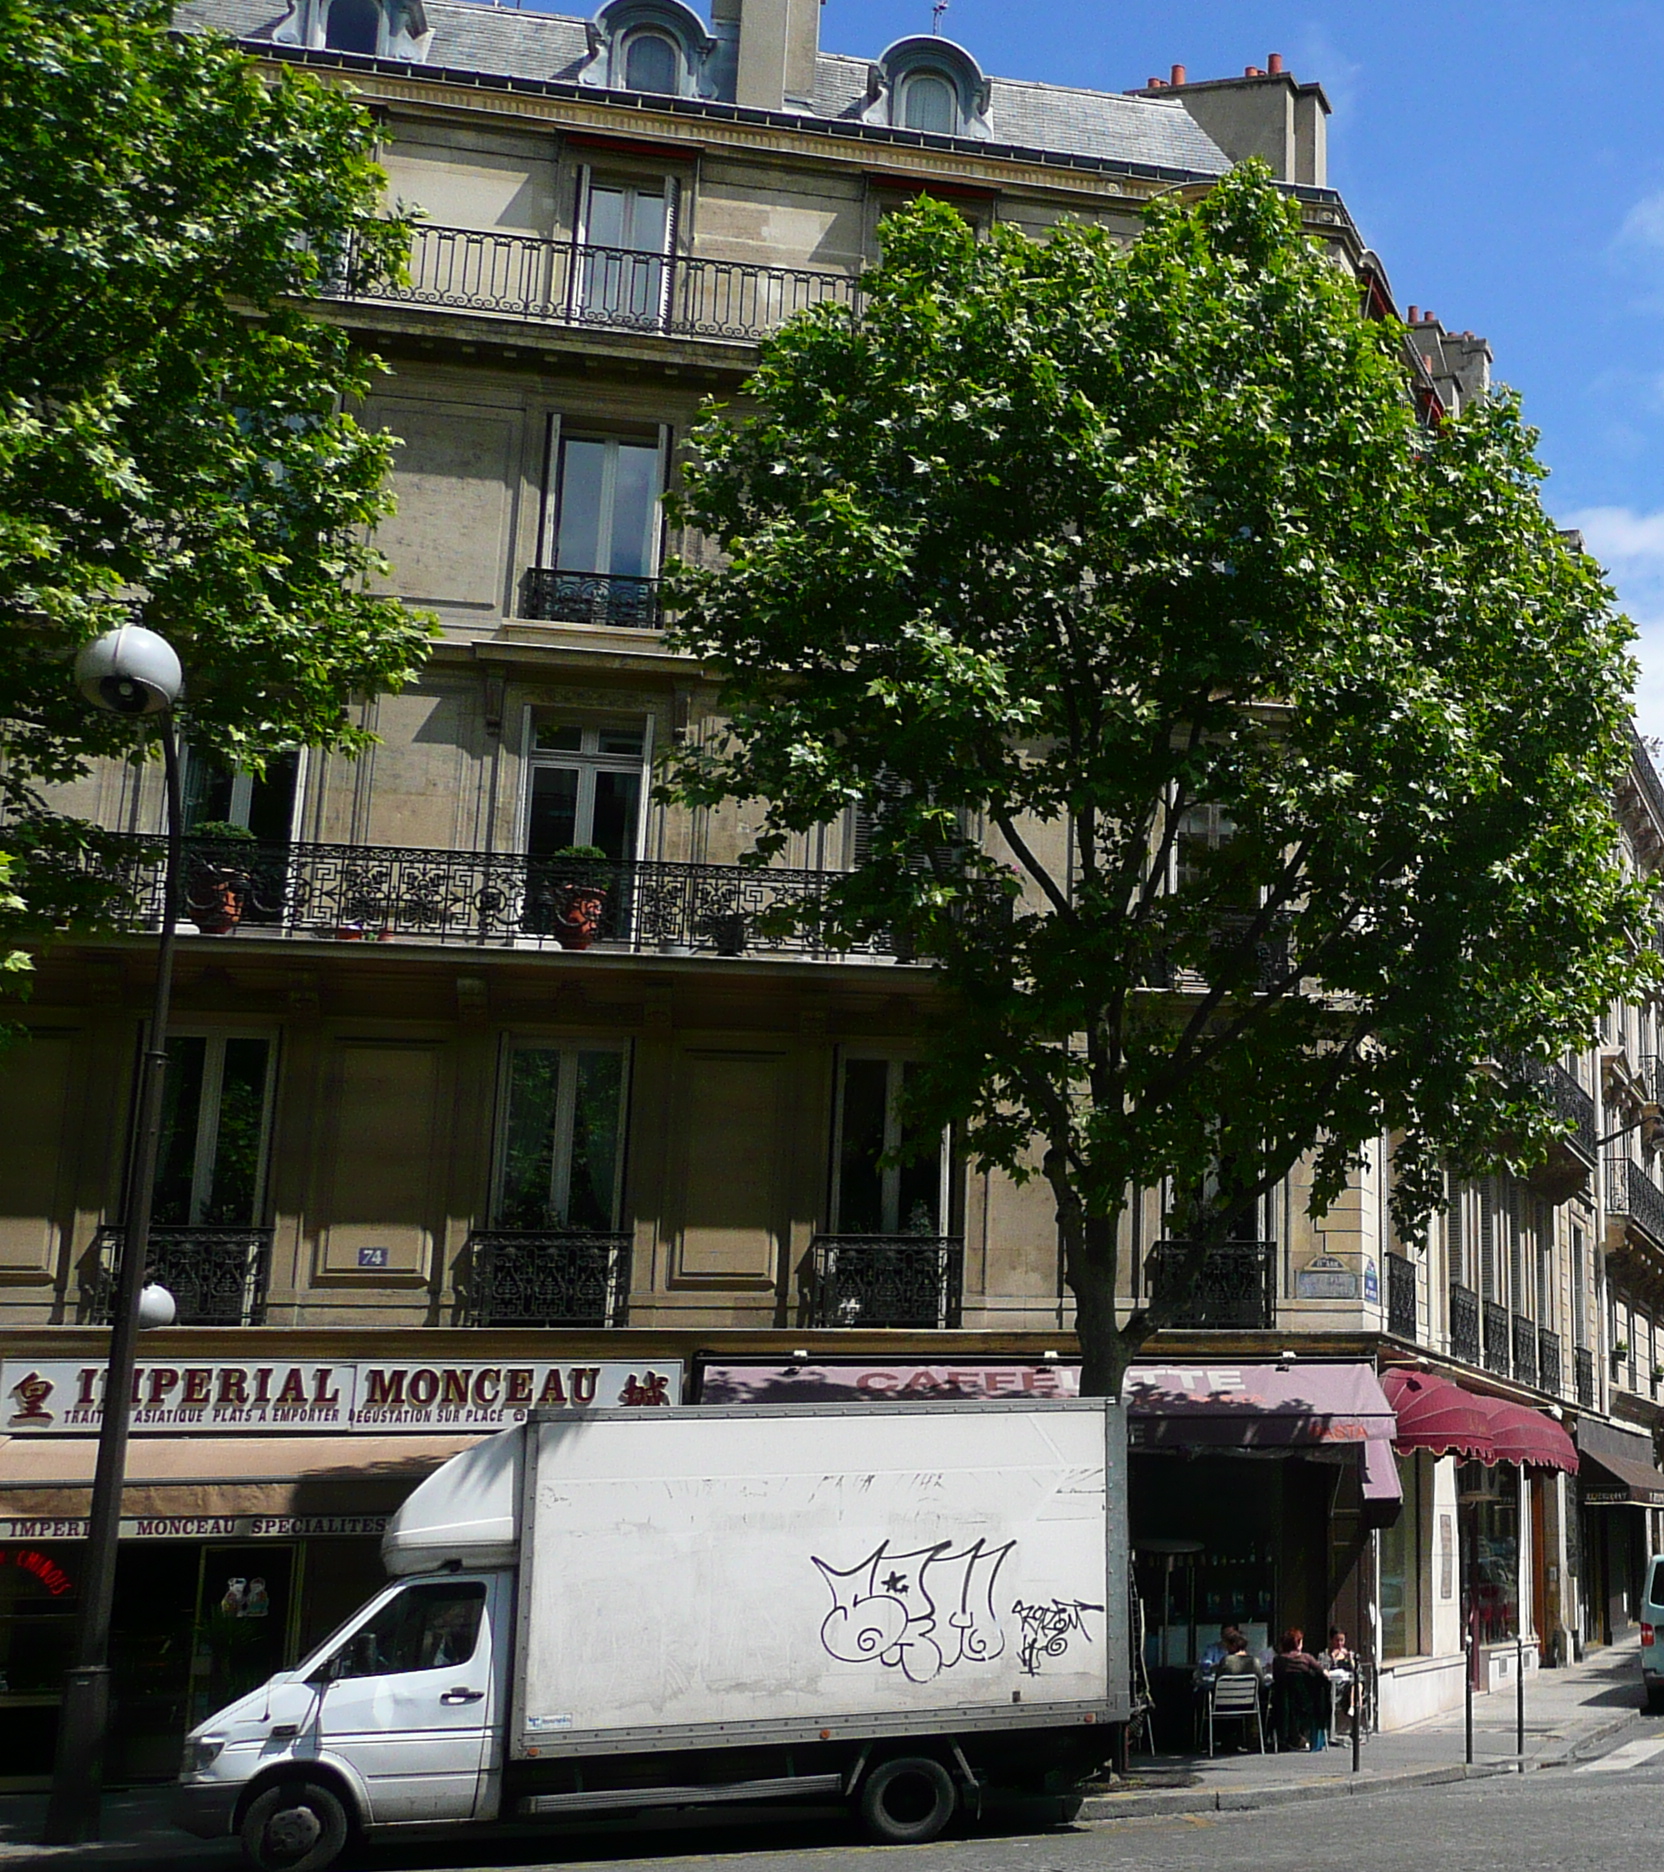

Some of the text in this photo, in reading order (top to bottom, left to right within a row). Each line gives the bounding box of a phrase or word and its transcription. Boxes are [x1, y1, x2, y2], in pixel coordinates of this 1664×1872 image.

[362, 1250, 382, 1265] 74
[366, 1367, 600, 1405] MONCEAU
[13, 1371, 54, 1425] 皇
[63, 1409, 104, 1424] TRAIT
[133, 1408, 204, 1424] ASIATIQUE
[212, 1408, 253, 1423] PLATS
[272, 1408, 340, 1422] EMPORTER
[437, 1408, 461, 1423] SUR
[465, 1408, 504, 1422] PLACE
[1308, 1423, 1369, 1441] PASTA
[9, 1517, 386, 1538] IMPERI MONCEAU SPECIALITES
[17, 1550, 72, 1595] CHINOIS
